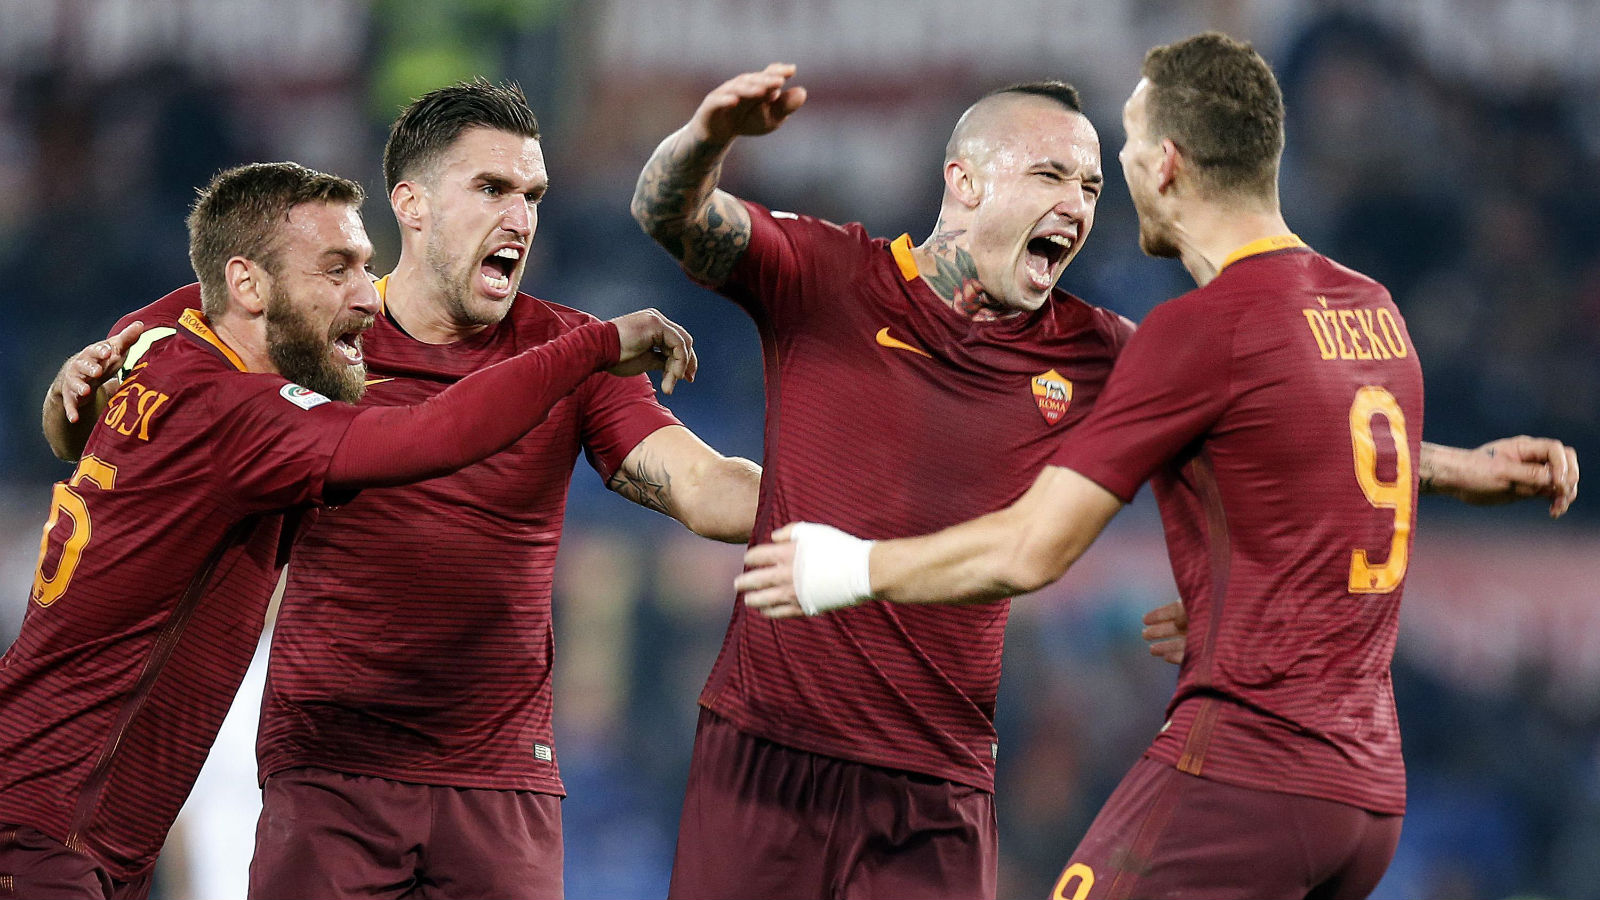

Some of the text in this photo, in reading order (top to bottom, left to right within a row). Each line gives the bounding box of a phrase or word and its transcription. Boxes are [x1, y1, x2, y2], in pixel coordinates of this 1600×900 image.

[183, 313, 209, 335] ROMA
[1302, 294, 1408, 361] DŽEKO
[1038, 398, 1067, 414] ROMA
[1347, 385, 1414, 594] 9
